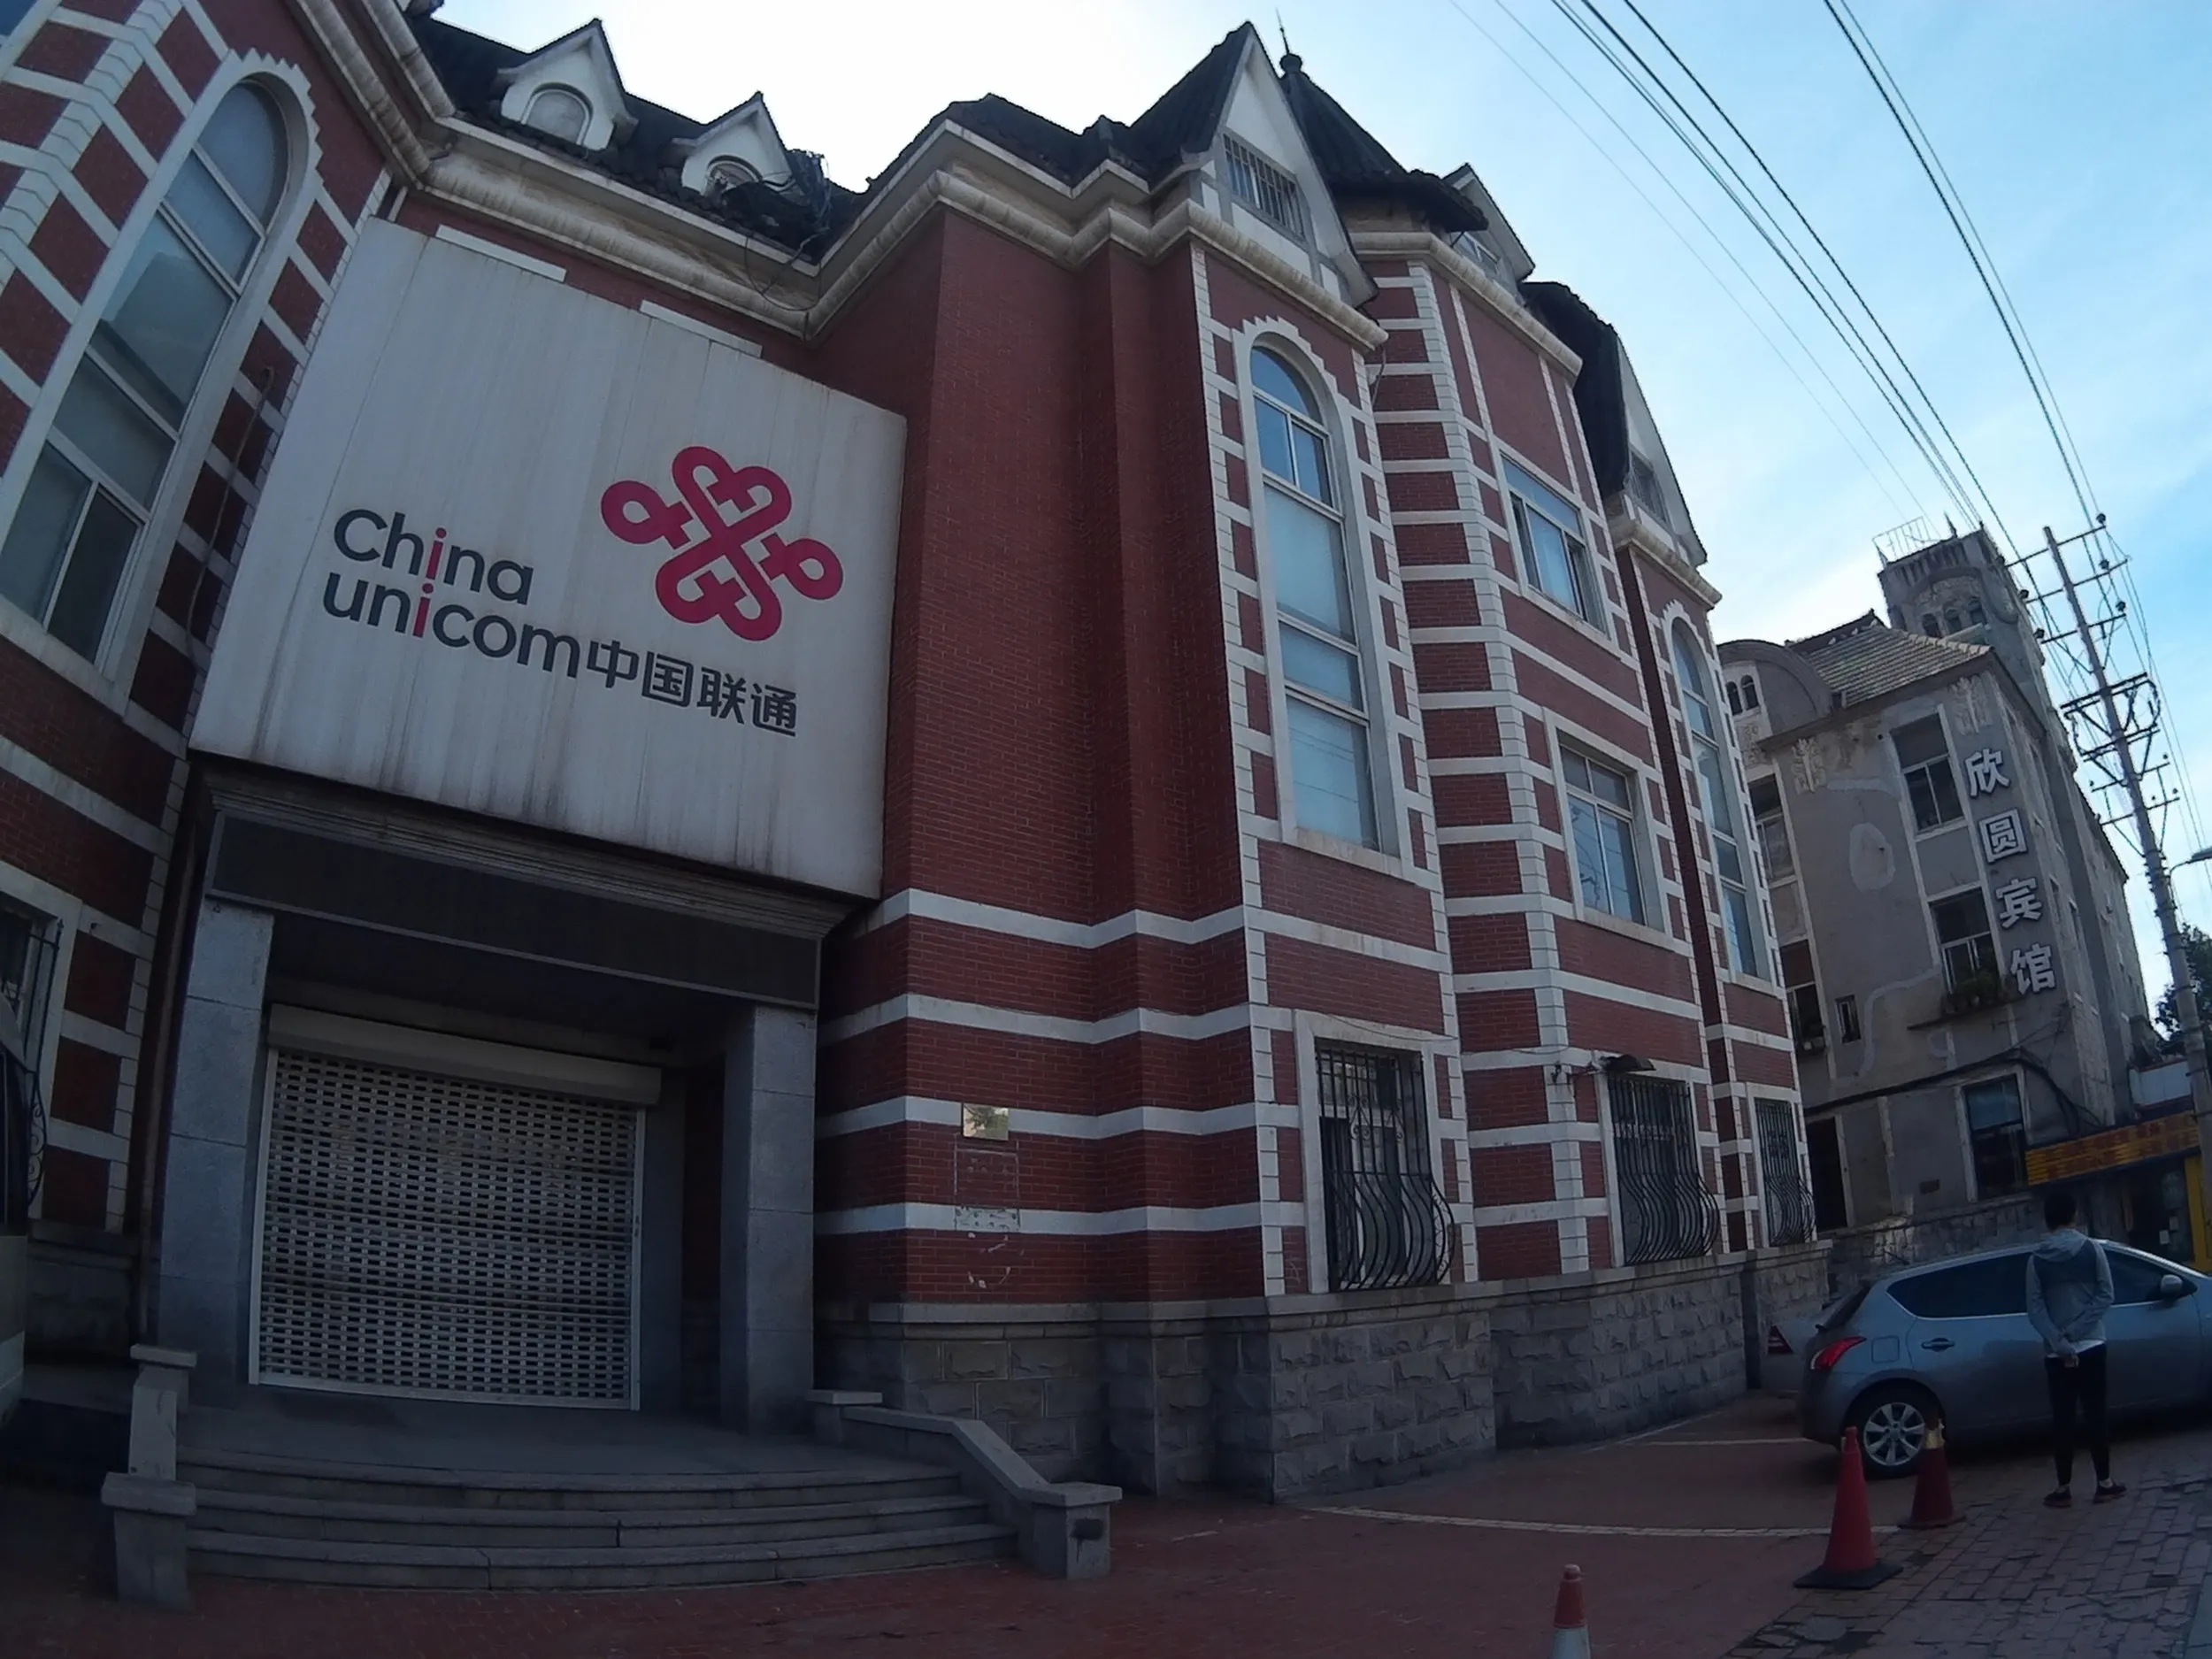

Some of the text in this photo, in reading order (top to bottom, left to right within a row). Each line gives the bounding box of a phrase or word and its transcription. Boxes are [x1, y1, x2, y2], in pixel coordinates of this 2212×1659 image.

[334, 509, 534, 605] China
[323, 572, 581, 679] unicom
[587, 640, 796, 737] 中国联通
[1964, 749, 2055, 995] 欣圆宾馆
